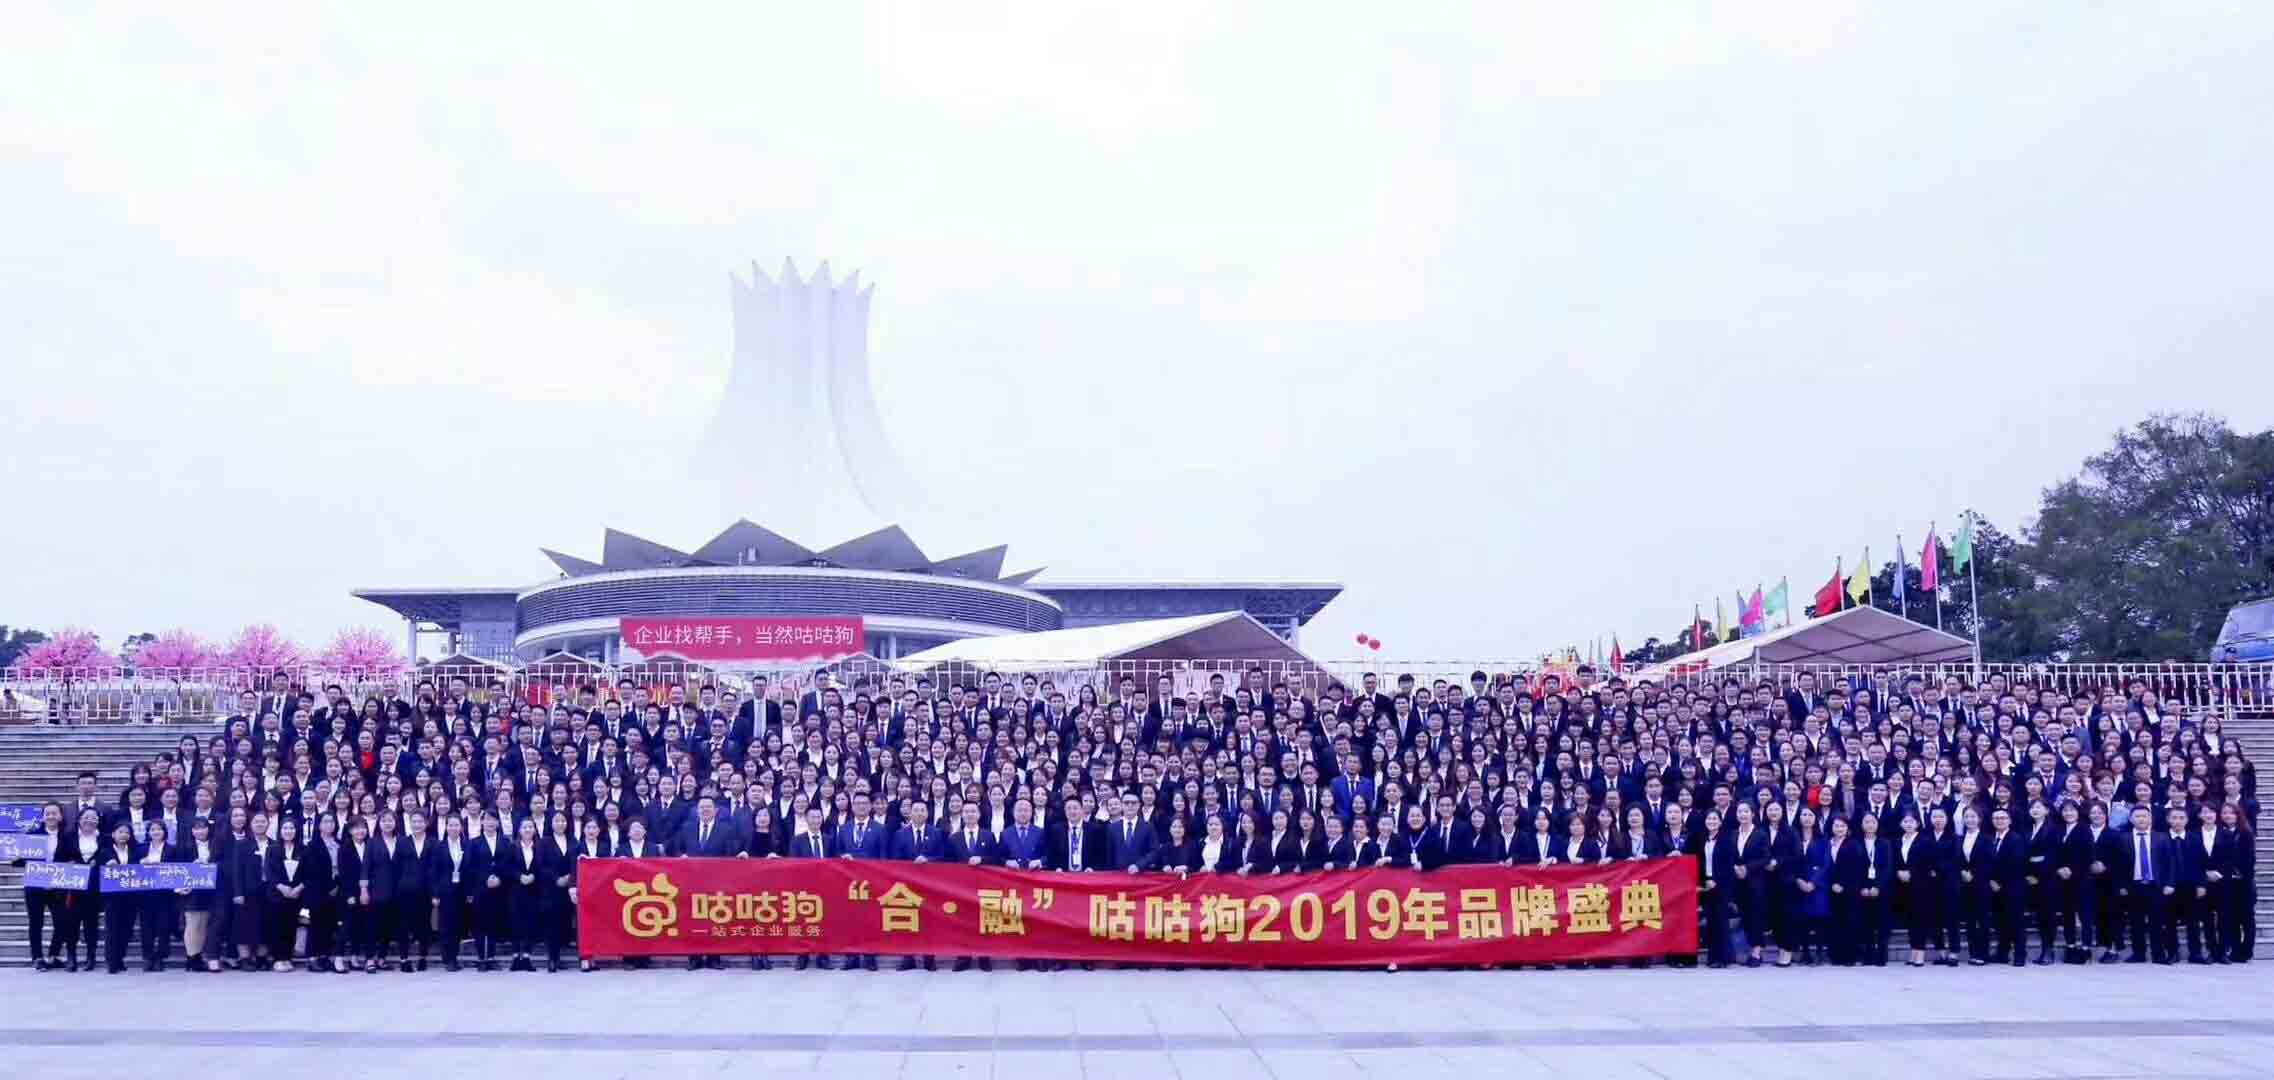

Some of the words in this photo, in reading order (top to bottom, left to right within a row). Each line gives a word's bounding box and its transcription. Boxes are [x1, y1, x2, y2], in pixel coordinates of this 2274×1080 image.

[634, 625, 854, 645] 企业找帮手，当然咕咕狗
[691, 891, 823, 923] 咕咕狗
[1089, 880, 1663, 943] 咕咕狗2019年品牌盛典
[691, 924, 822, 937] 一站式企业服务
